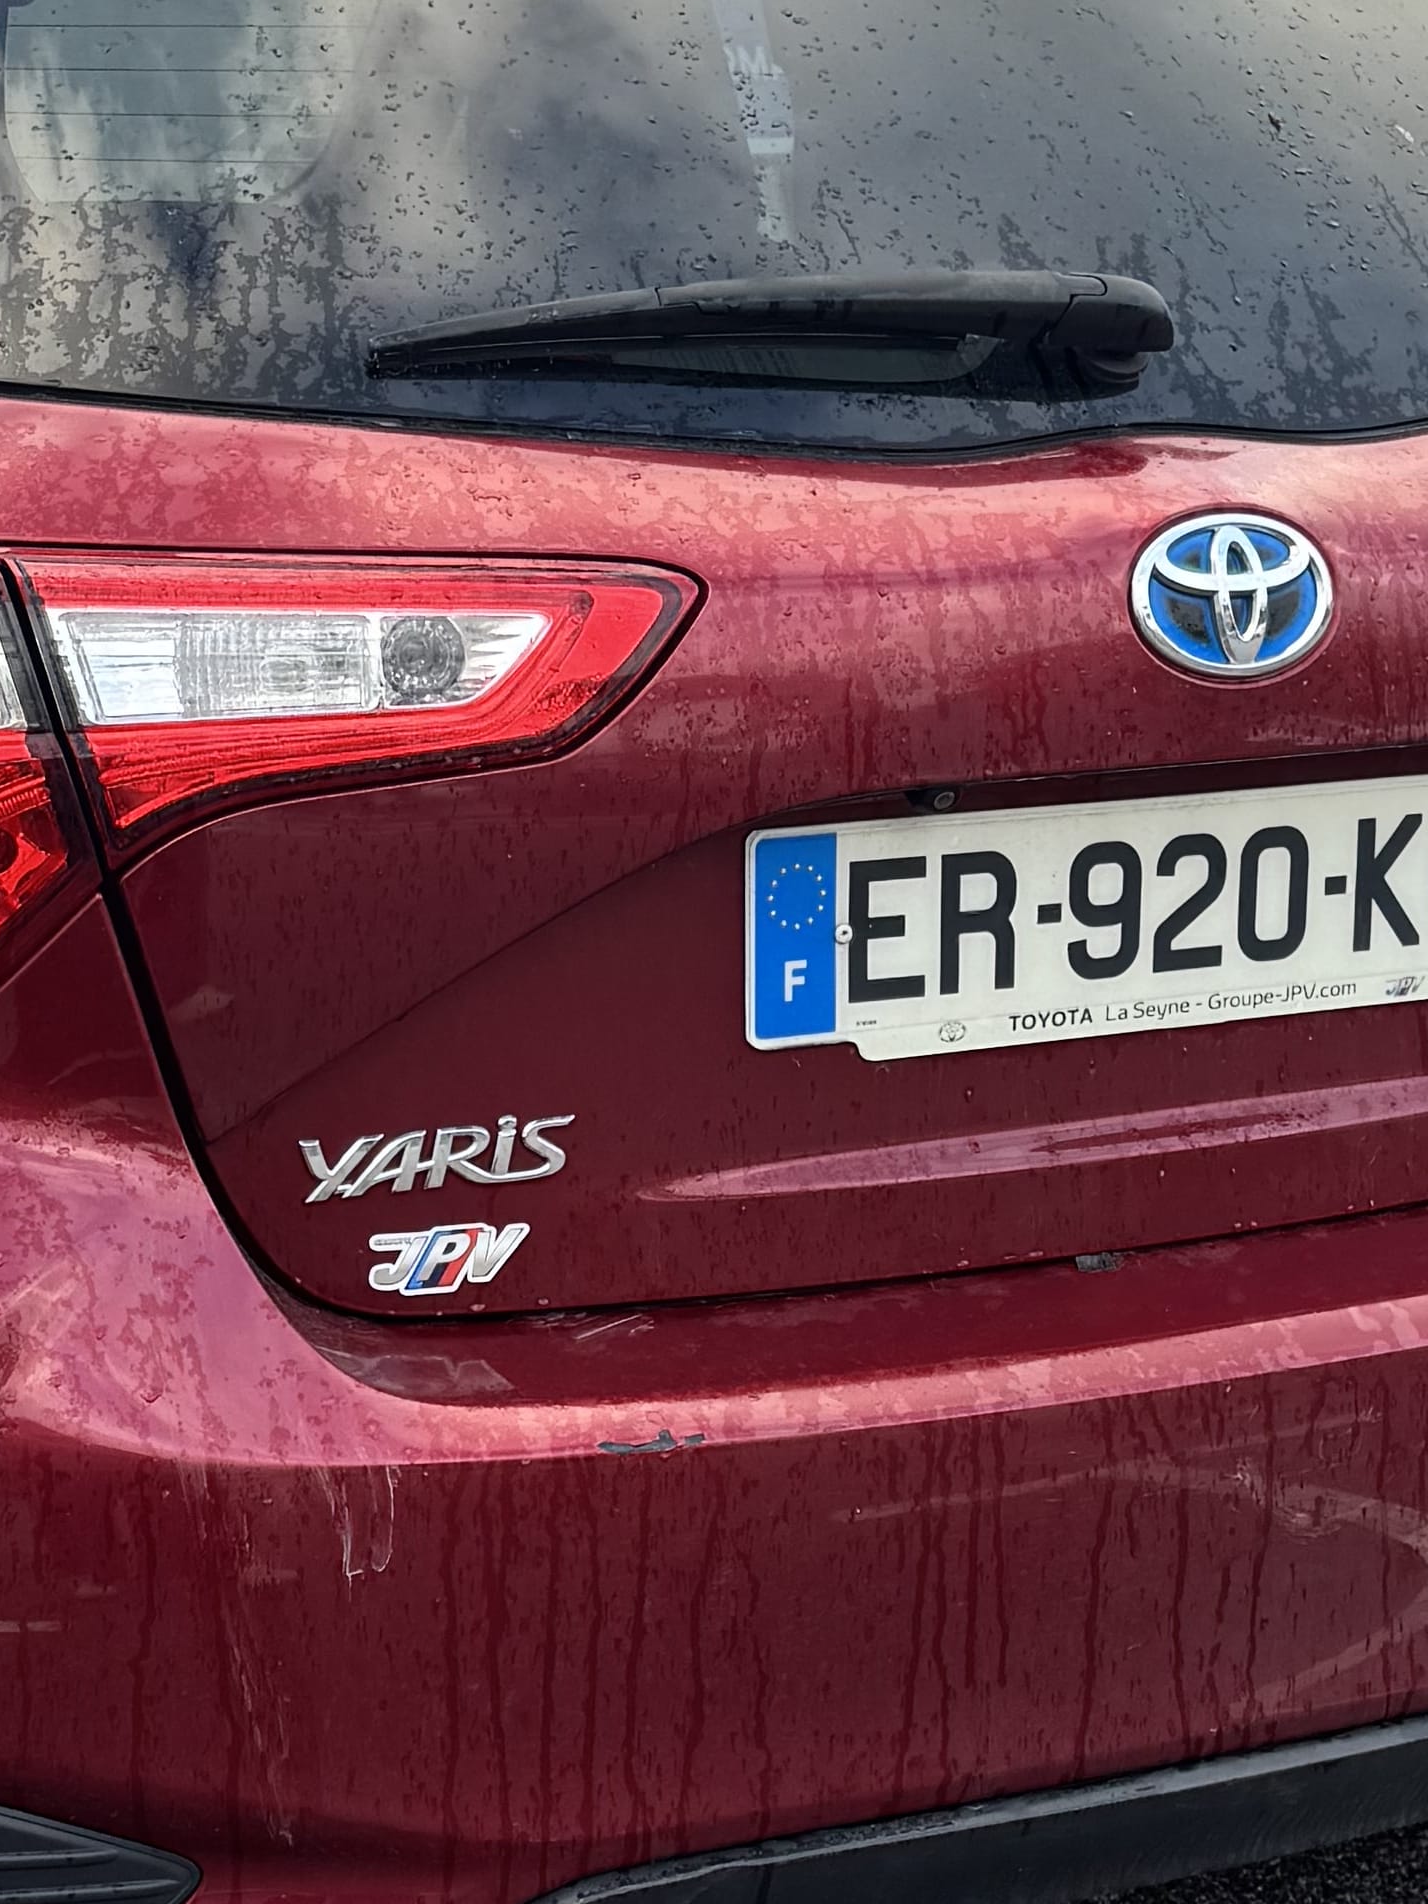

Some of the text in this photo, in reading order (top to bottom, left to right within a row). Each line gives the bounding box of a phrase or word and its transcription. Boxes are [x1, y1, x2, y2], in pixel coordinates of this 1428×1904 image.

[783, 960, 808, 1003] F
[1009, 1008, 1093, 1032] TOYOTA
[1106, 1004, 1128, 1021] La
[1133, 1001, 1190, 1020] Seyne
[1208, 982, 1357, 1010] Groupe-JPV.com
[371, 1225, 527, 1292] JPV
